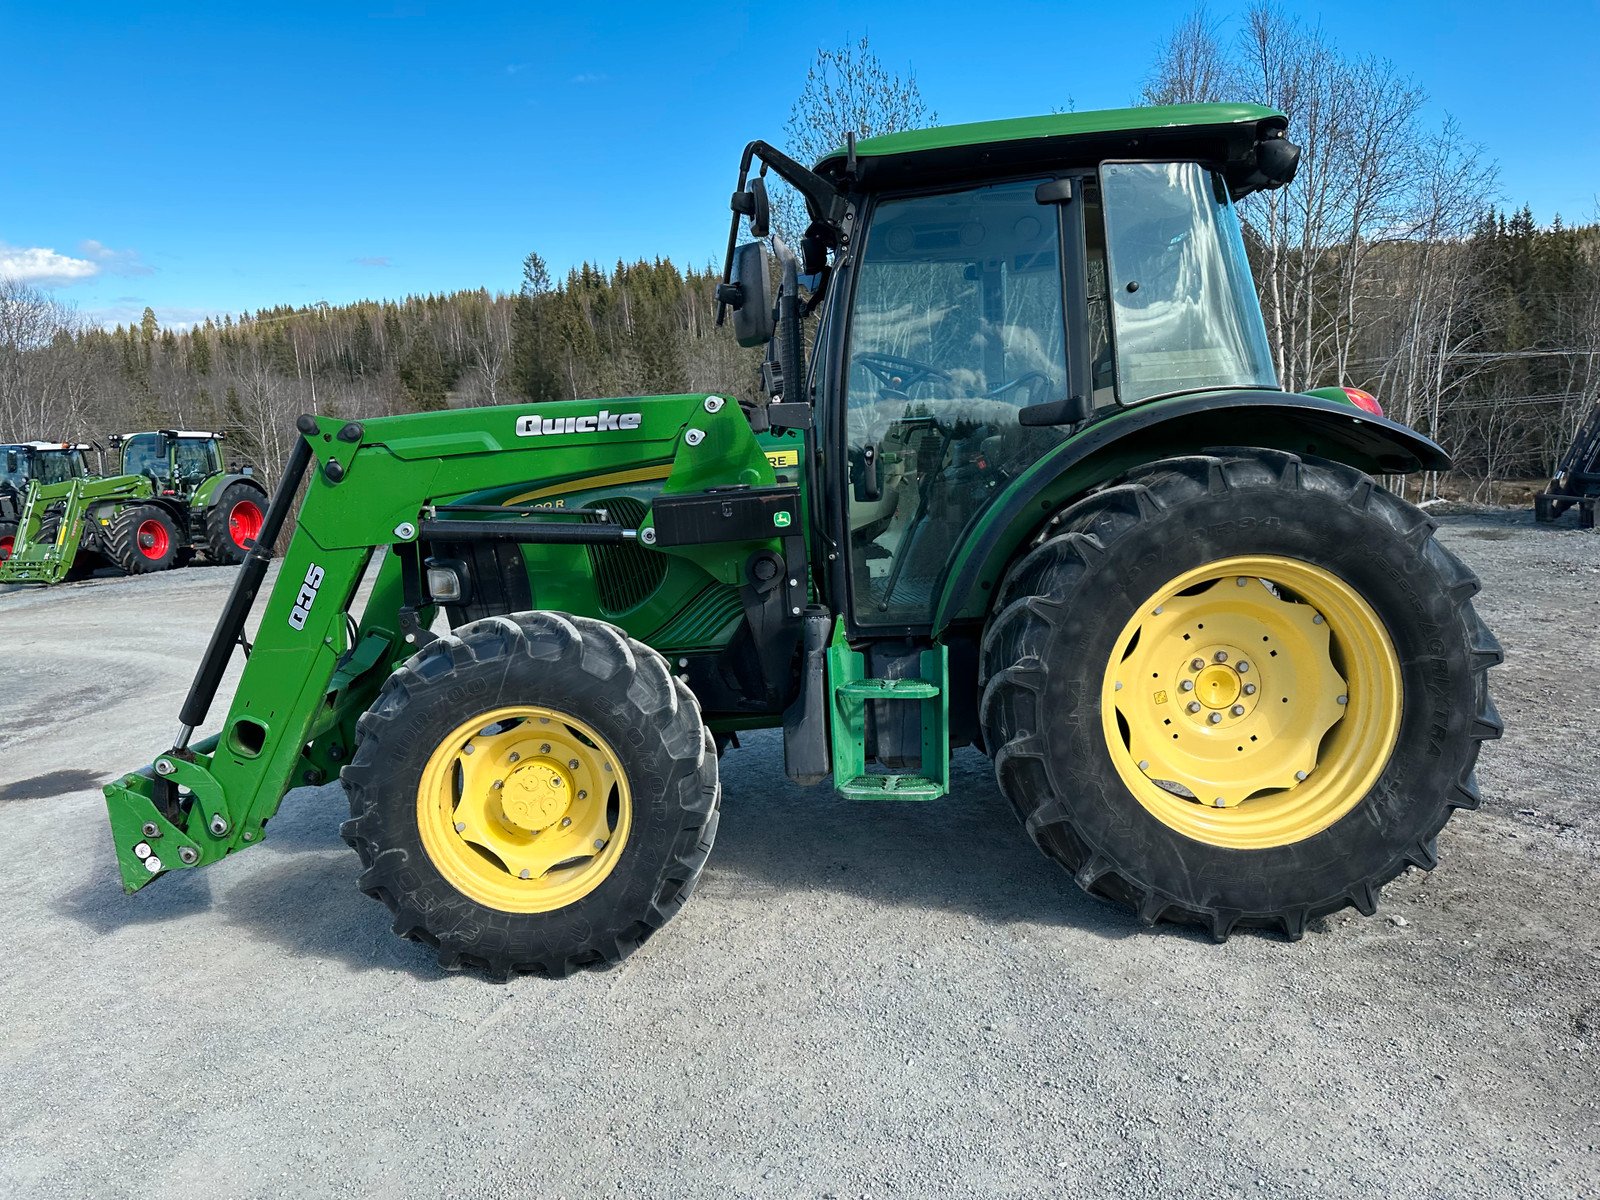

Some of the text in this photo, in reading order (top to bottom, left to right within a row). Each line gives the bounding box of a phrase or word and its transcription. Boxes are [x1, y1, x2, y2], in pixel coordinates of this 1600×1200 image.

[515, 409, 642, 437] Quicke
[288, 562, 325, 631] Q35
[1417, 621, 1451, 758] AGRIXTRA
